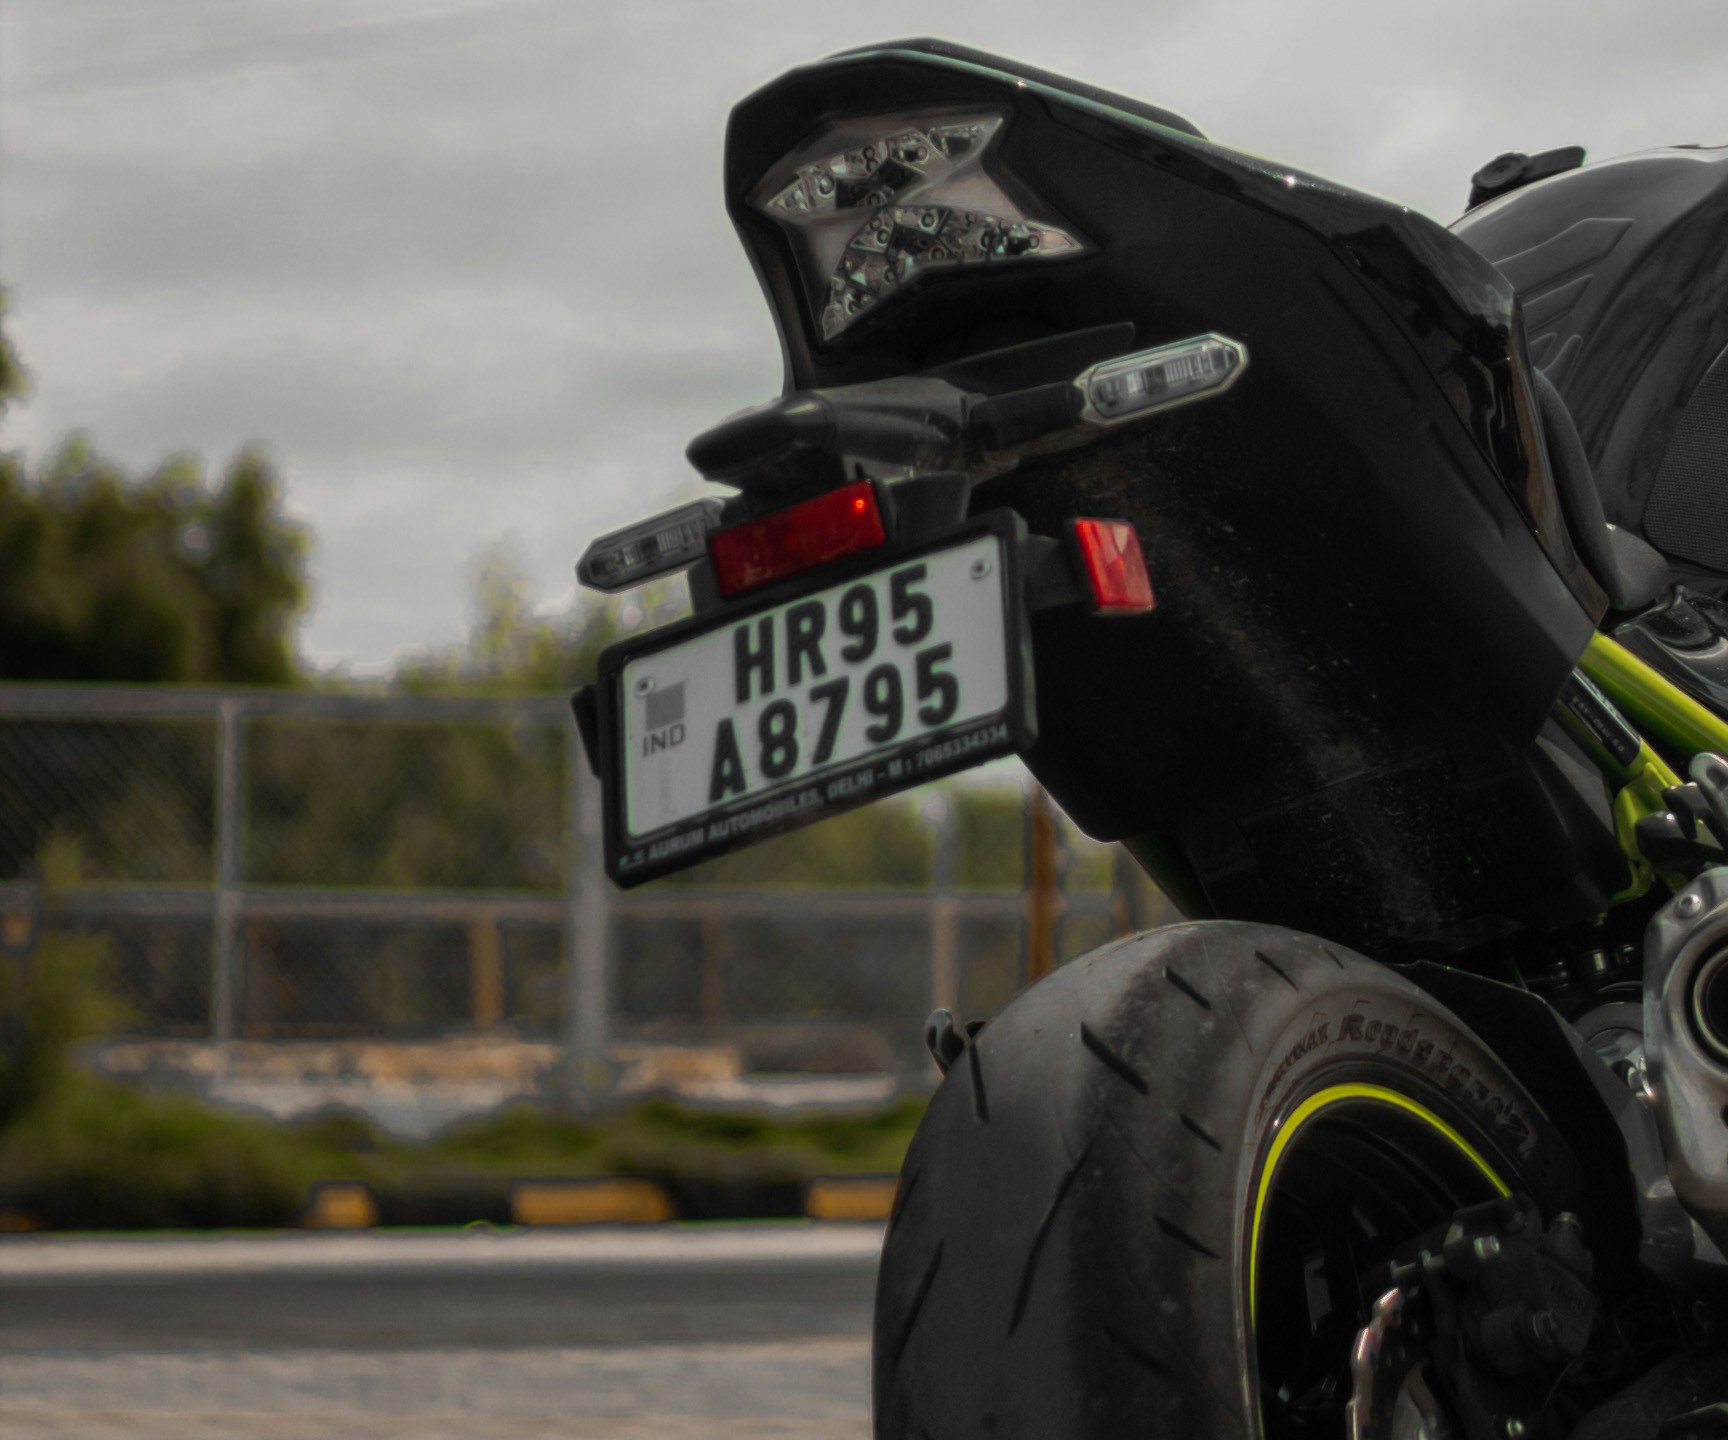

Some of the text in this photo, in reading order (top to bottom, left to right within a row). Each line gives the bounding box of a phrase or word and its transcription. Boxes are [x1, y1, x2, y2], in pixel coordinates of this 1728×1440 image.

[733, 562, 934, 704] HR95
[642, 722, 686, 759] IND
[708, 641, 960, 803] A8795
[648, 827, 705, 861] AURUM
[827, 768, 875, 801] DELHI
